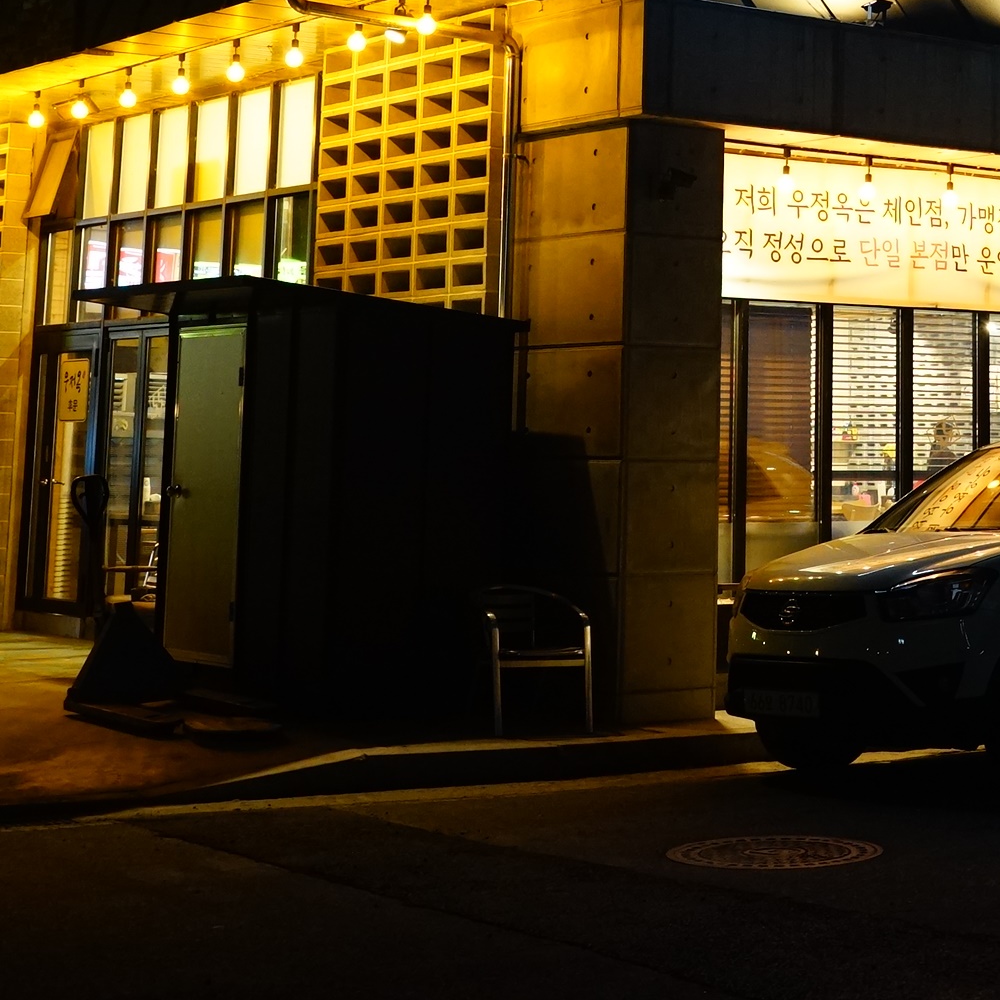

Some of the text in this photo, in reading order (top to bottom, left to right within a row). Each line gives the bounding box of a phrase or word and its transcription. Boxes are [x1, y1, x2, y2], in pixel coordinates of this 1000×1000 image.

[735, 184, 776, 216] 저희
[787, 190, 875, 224] 우정옥은
[883, 196, 949, 229] 체인점,
[763, 231, 852, 264] 정성으로
[859, 237, 901, 268] 단일
[910, 240, 969, 272] 본점만
[64, 370, 81, 393] 우정옥
[67, 399, 78, 412] 후문
